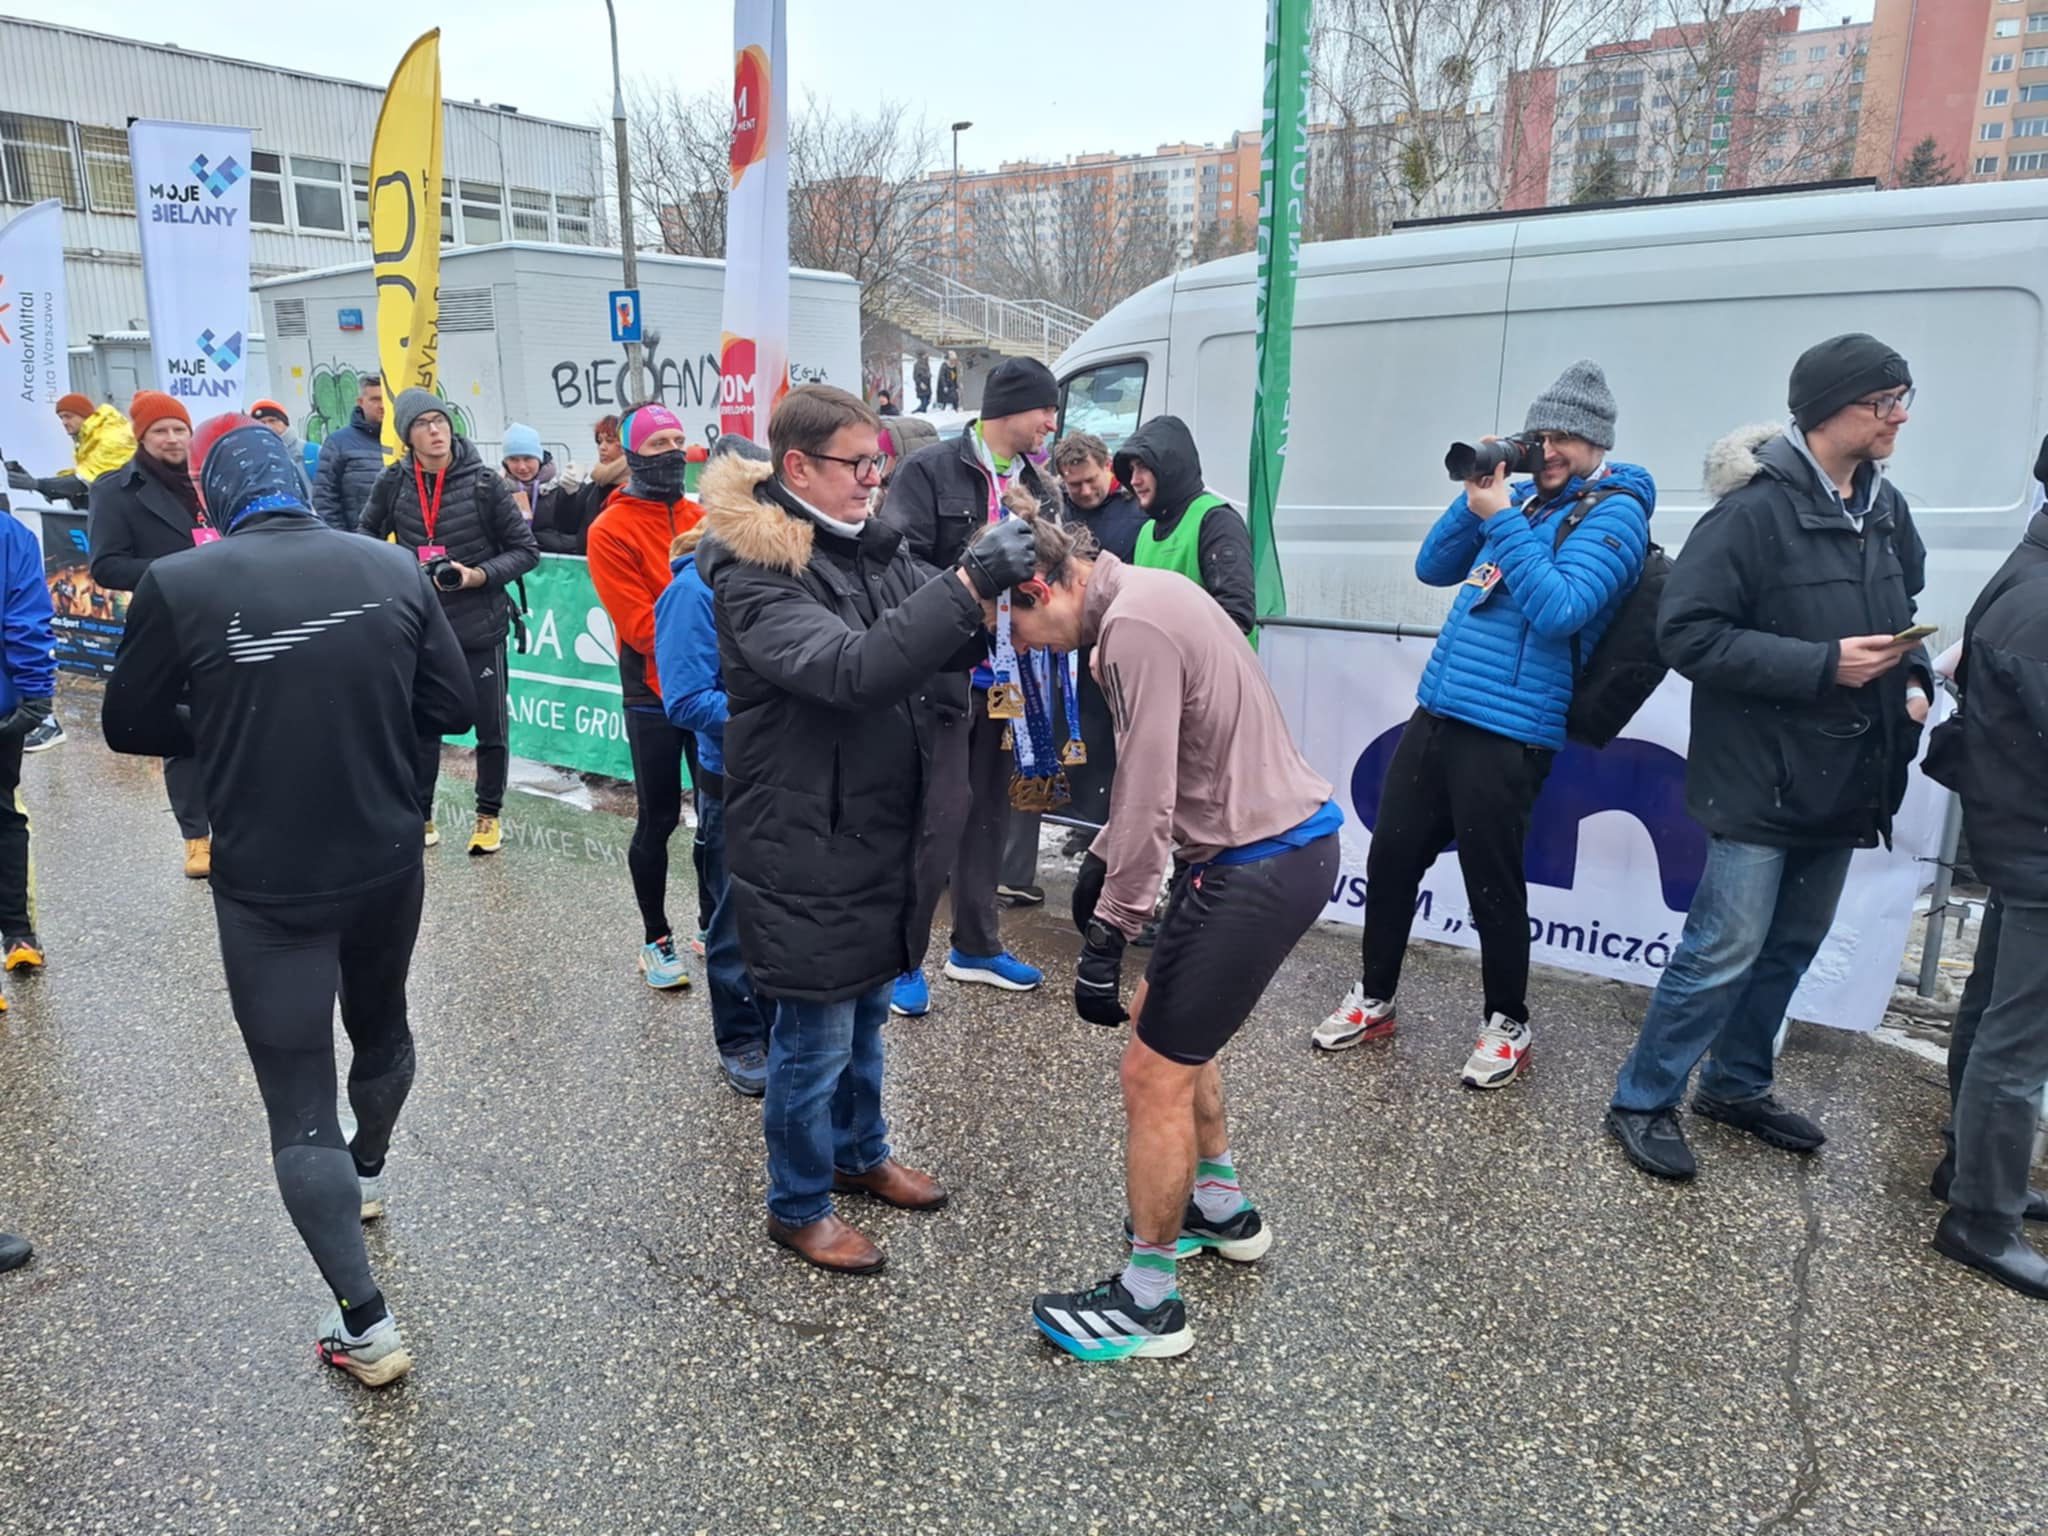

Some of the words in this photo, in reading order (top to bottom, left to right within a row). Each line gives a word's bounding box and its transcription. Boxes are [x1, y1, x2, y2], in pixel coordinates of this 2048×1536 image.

[152, 203, 238, 227] BIELANY
[19, 291, 36, 403] ArcelorMittal
[43, 291, 55, 367] Warszawa
[720, 373, 757, 403] OM
